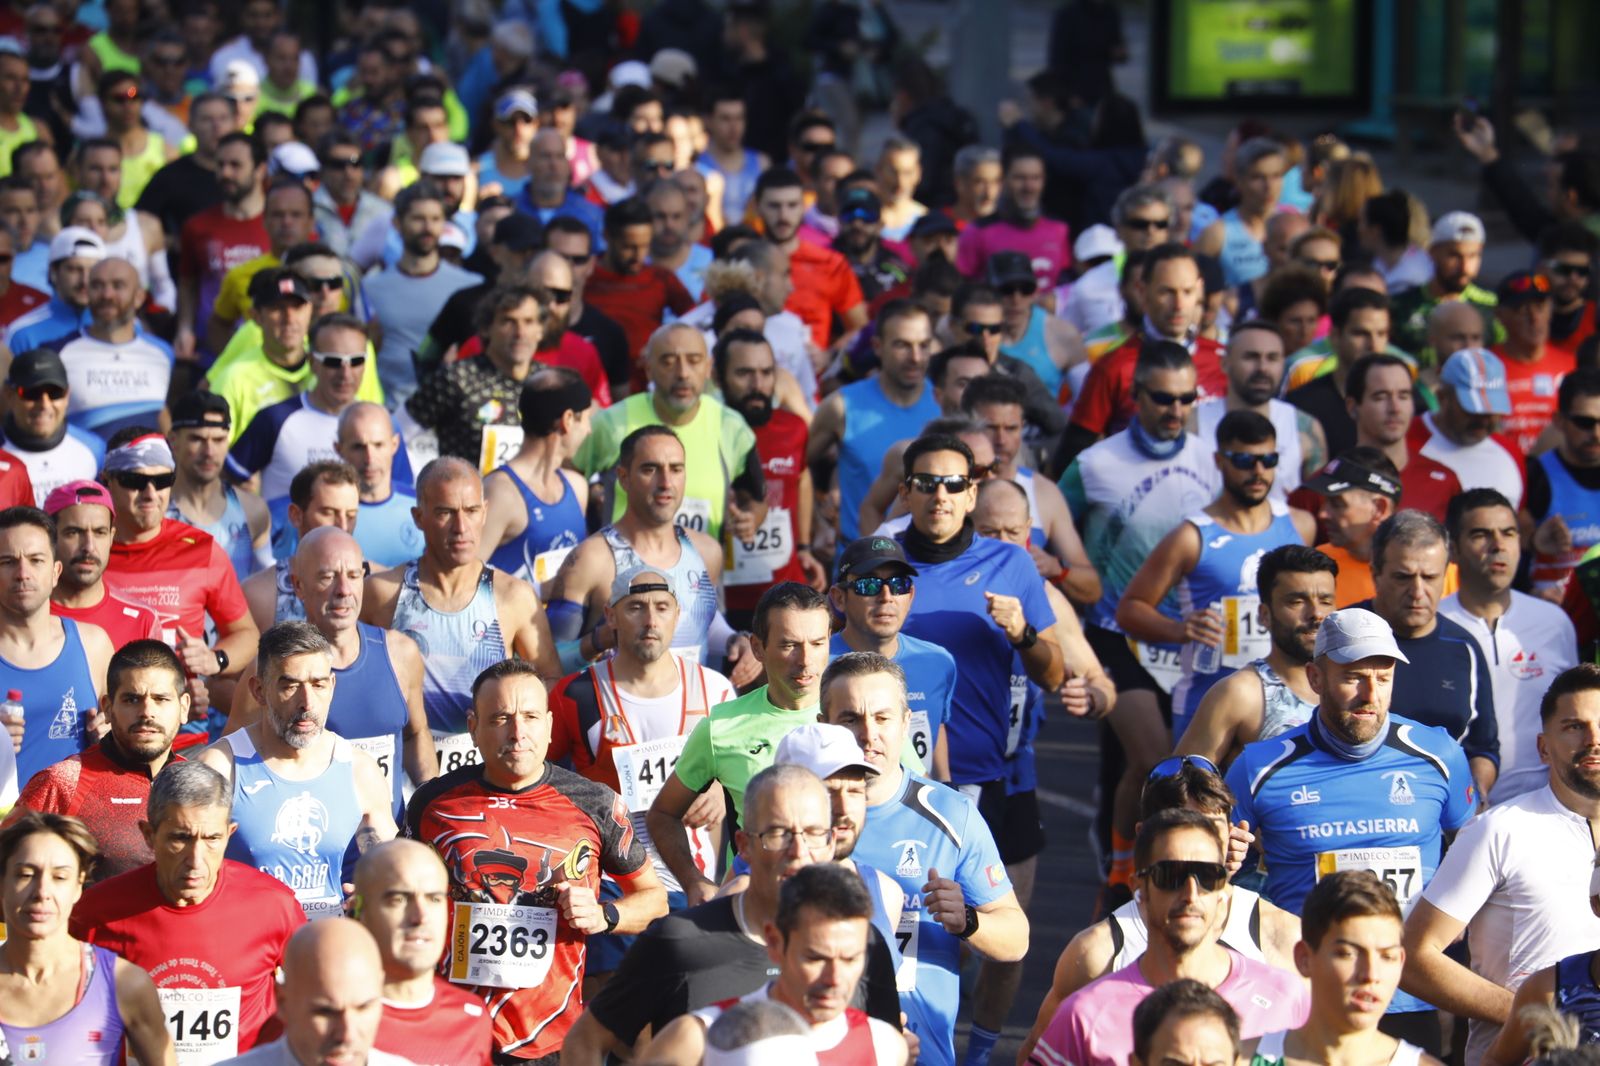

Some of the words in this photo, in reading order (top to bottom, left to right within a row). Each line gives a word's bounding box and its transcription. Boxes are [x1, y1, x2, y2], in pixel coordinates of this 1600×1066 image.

[158, 593, 180, 606] 2022
[912, 731, 928, 759] 6
[1290, 785, 1321, 803] als
[1296, 818, 1420, 840] TROTASIERRA
[1350, 852, 1390, 861] IMDECO
[1364, 868, 1415, 899] 57
[483, 907, 524, 918] IMDECO
[470, 923, 548, 960] 2363
[895, 932, 912, 954] 7
[169, 1009, 232, 1041] 146
